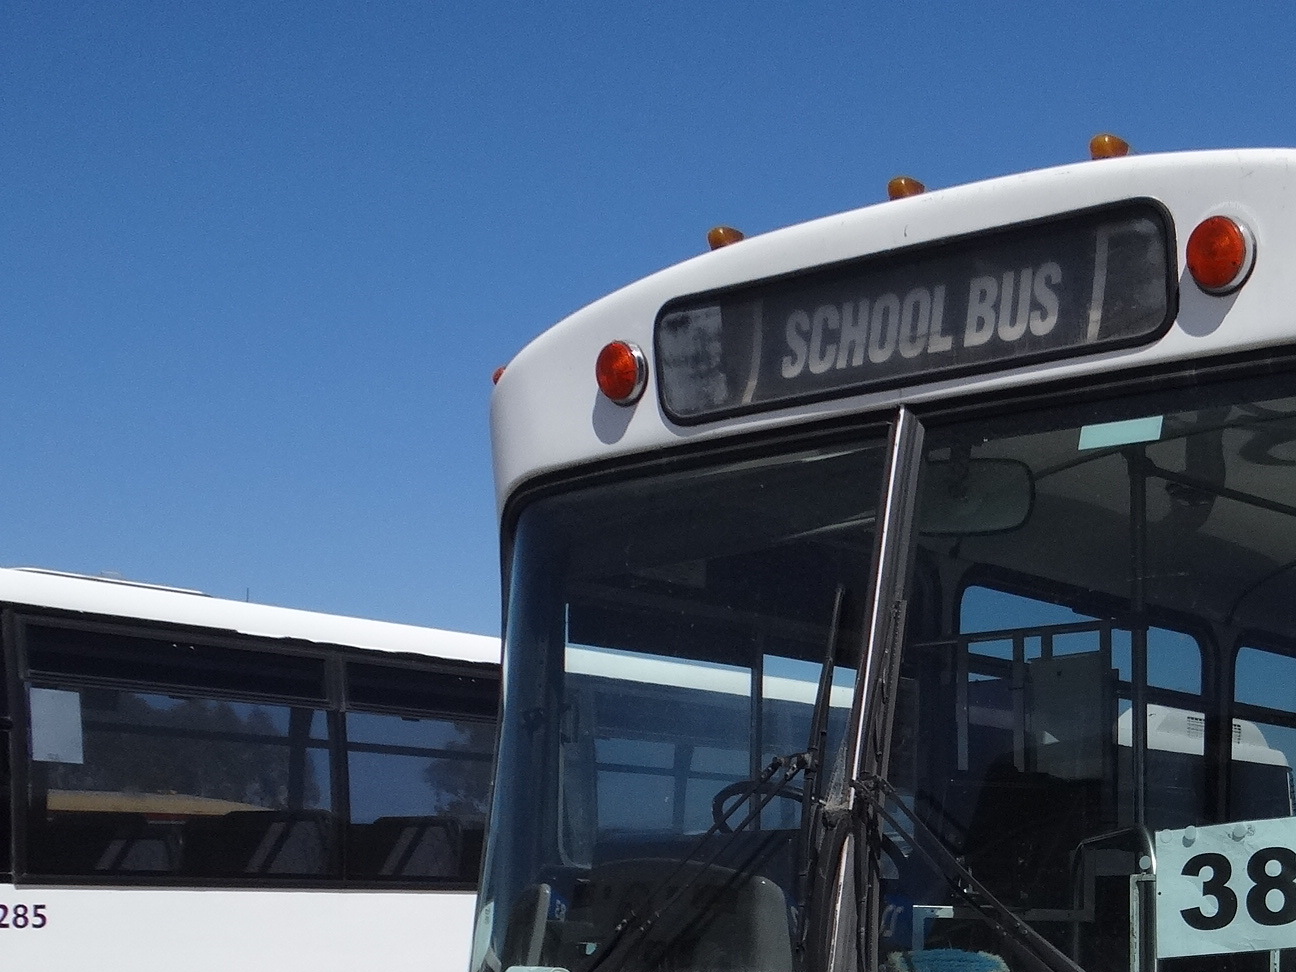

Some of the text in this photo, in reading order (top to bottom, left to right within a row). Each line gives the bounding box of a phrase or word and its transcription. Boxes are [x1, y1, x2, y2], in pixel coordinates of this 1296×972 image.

[780, 261, 1063, 380] SCHOOL BUS
[0, 904, 47, 929] 285
